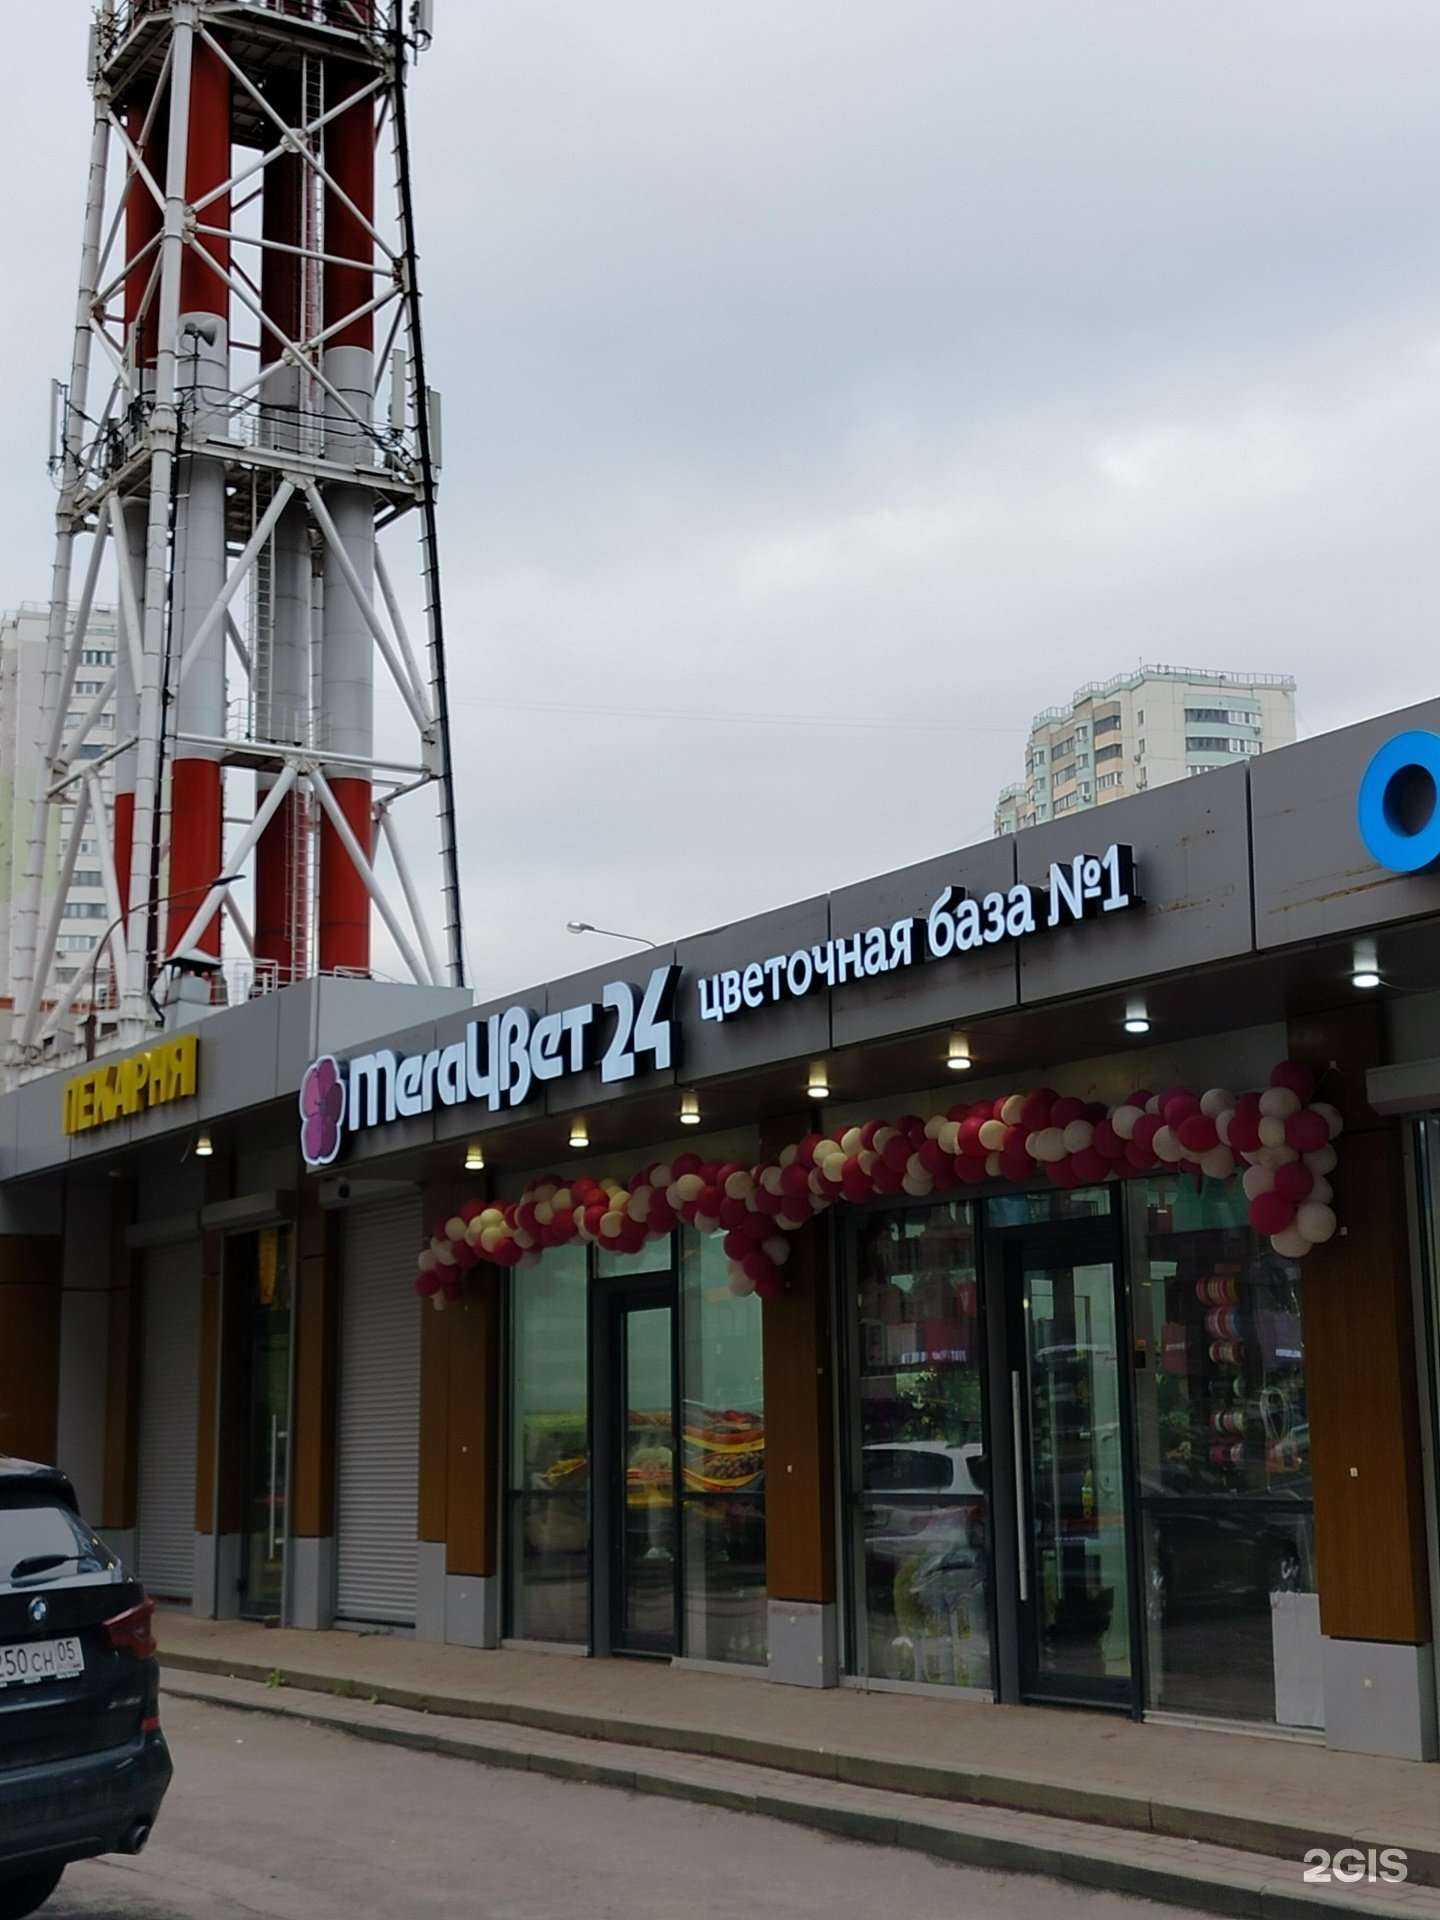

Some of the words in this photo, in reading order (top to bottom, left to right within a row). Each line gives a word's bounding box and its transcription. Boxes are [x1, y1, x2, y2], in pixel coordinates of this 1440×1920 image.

[698, 916, 915, 1022] цветочная
[927, 885, 1036, 957] база
[1046, 843, 1130, 926] №1
[601, 965, 673, 1083] 24
[64, 1034, 198, 1135] ПЕКАРНЯ
